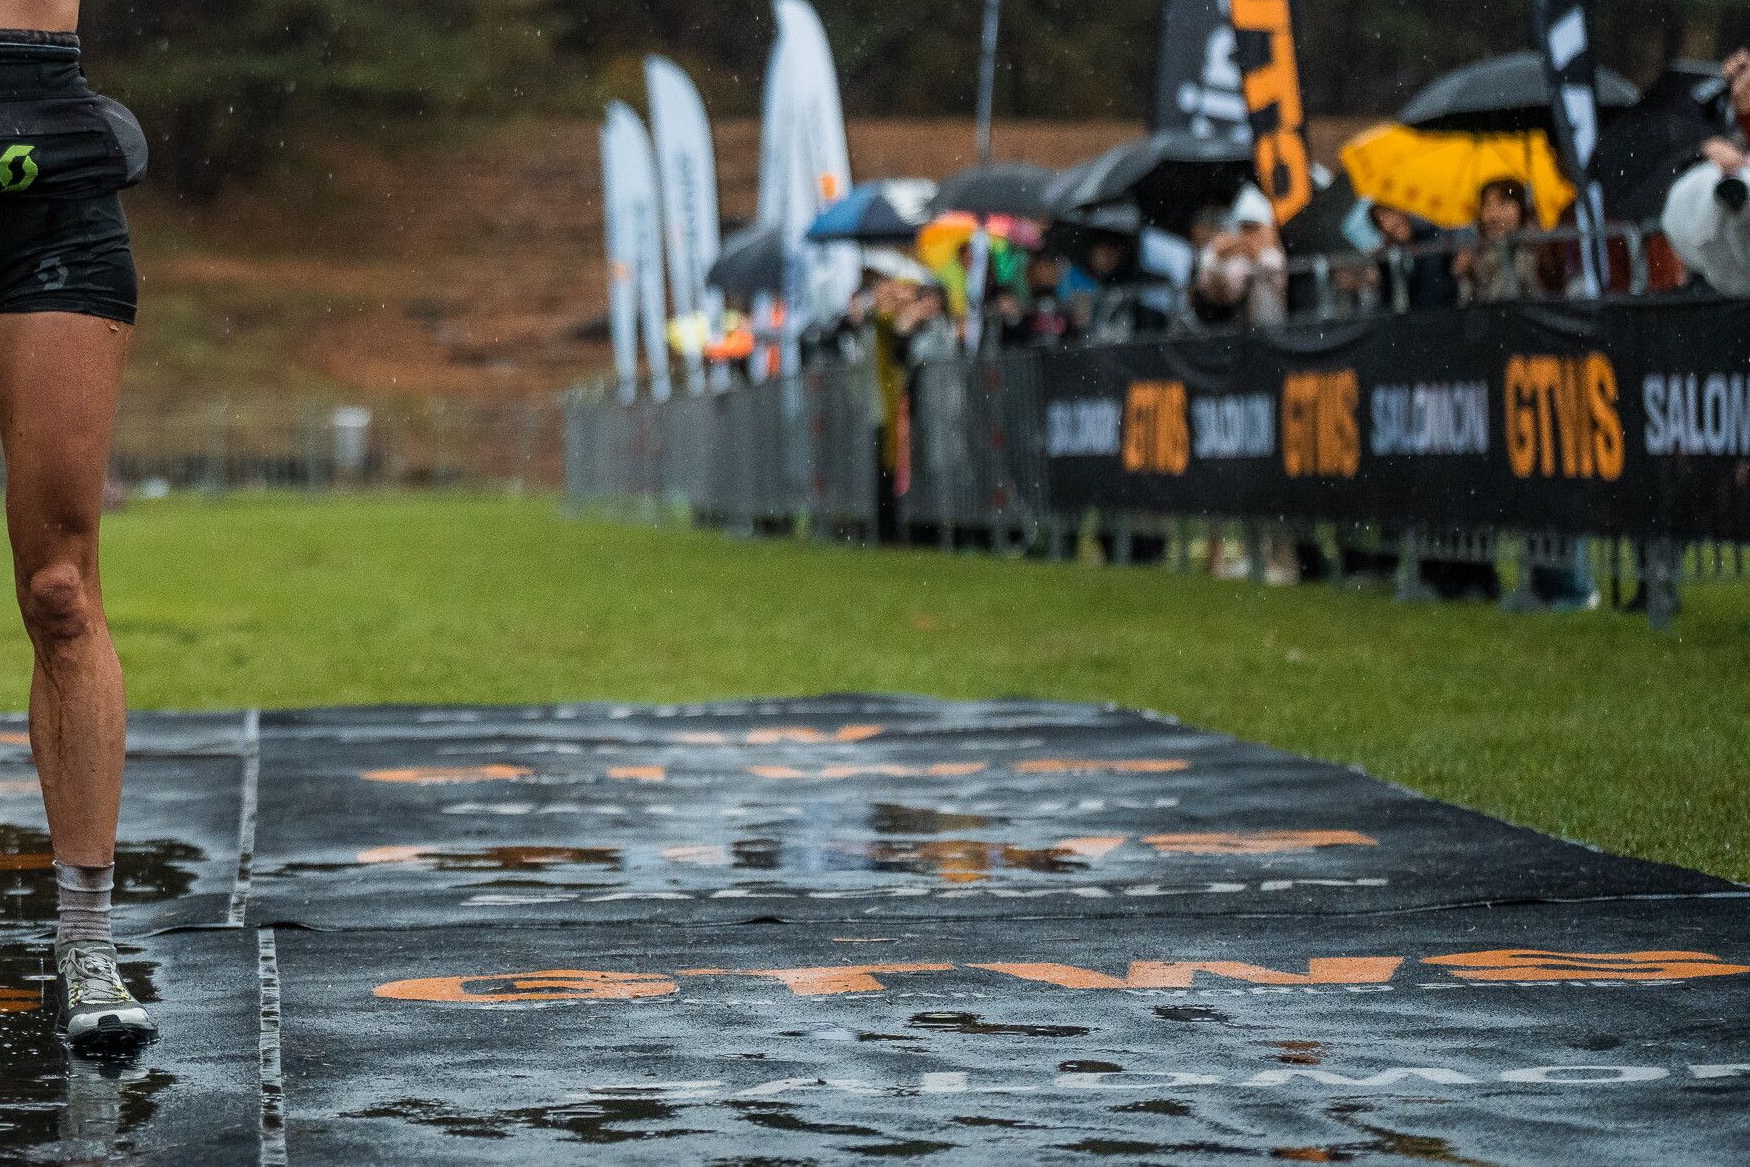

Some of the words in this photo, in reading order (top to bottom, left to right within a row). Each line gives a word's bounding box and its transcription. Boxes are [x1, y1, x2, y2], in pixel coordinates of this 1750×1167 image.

[1503, 351, 1625, 481] GTWS
[372, 949, 1750, 1002] GTWS
[1124, 985, 1392, 998] WORLD
